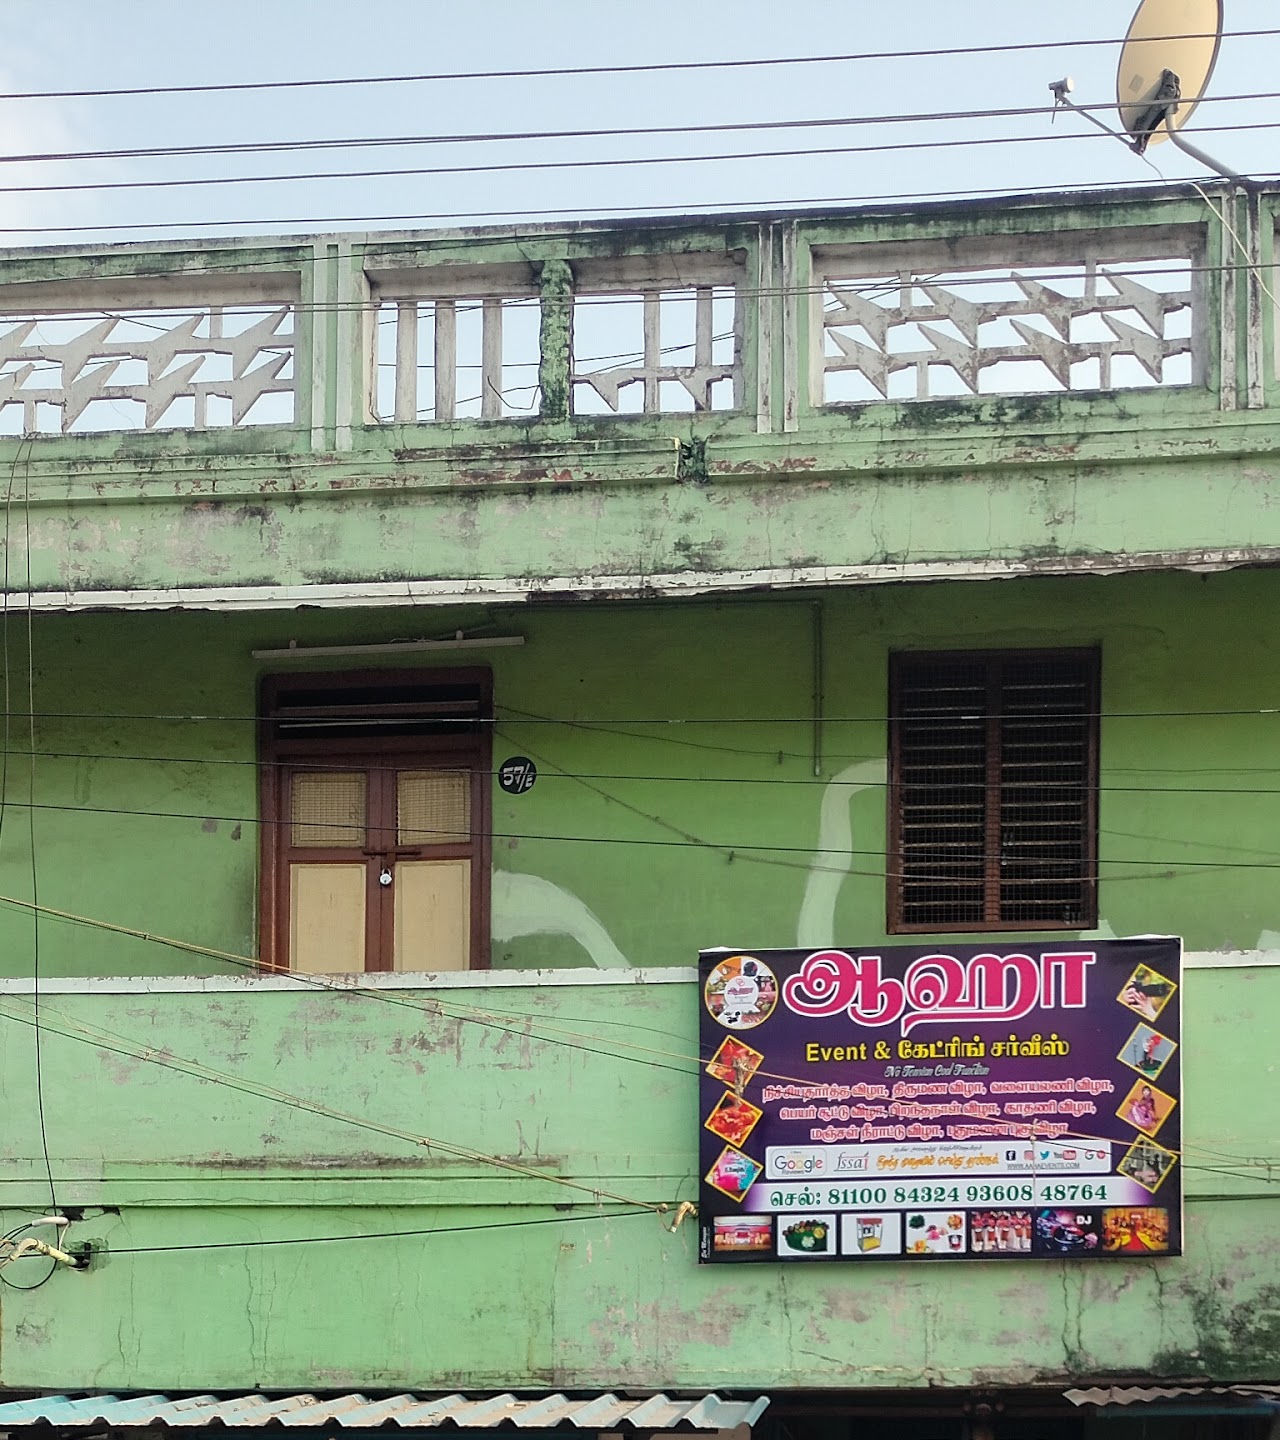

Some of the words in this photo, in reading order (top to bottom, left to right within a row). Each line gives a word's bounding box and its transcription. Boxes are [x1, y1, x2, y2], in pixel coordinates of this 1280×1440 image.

[784, 950, 1096, 1036] ஆஹா
[806, 1043, 867, 1061] Event
[874, 1041, 891, 1059] &
[775, 1155, 823, 1172] Google
[771, 1187, 820, 1206] செல்:
[828, 1188, 886, 1205] 81100
[894, 1187, 959, 1203] 84324
[966, 1185, 1033, 1201] 93608
[1040, 1184, 1107, 1201] 48764
[1076, 1215, 1092, 1225] DJ
